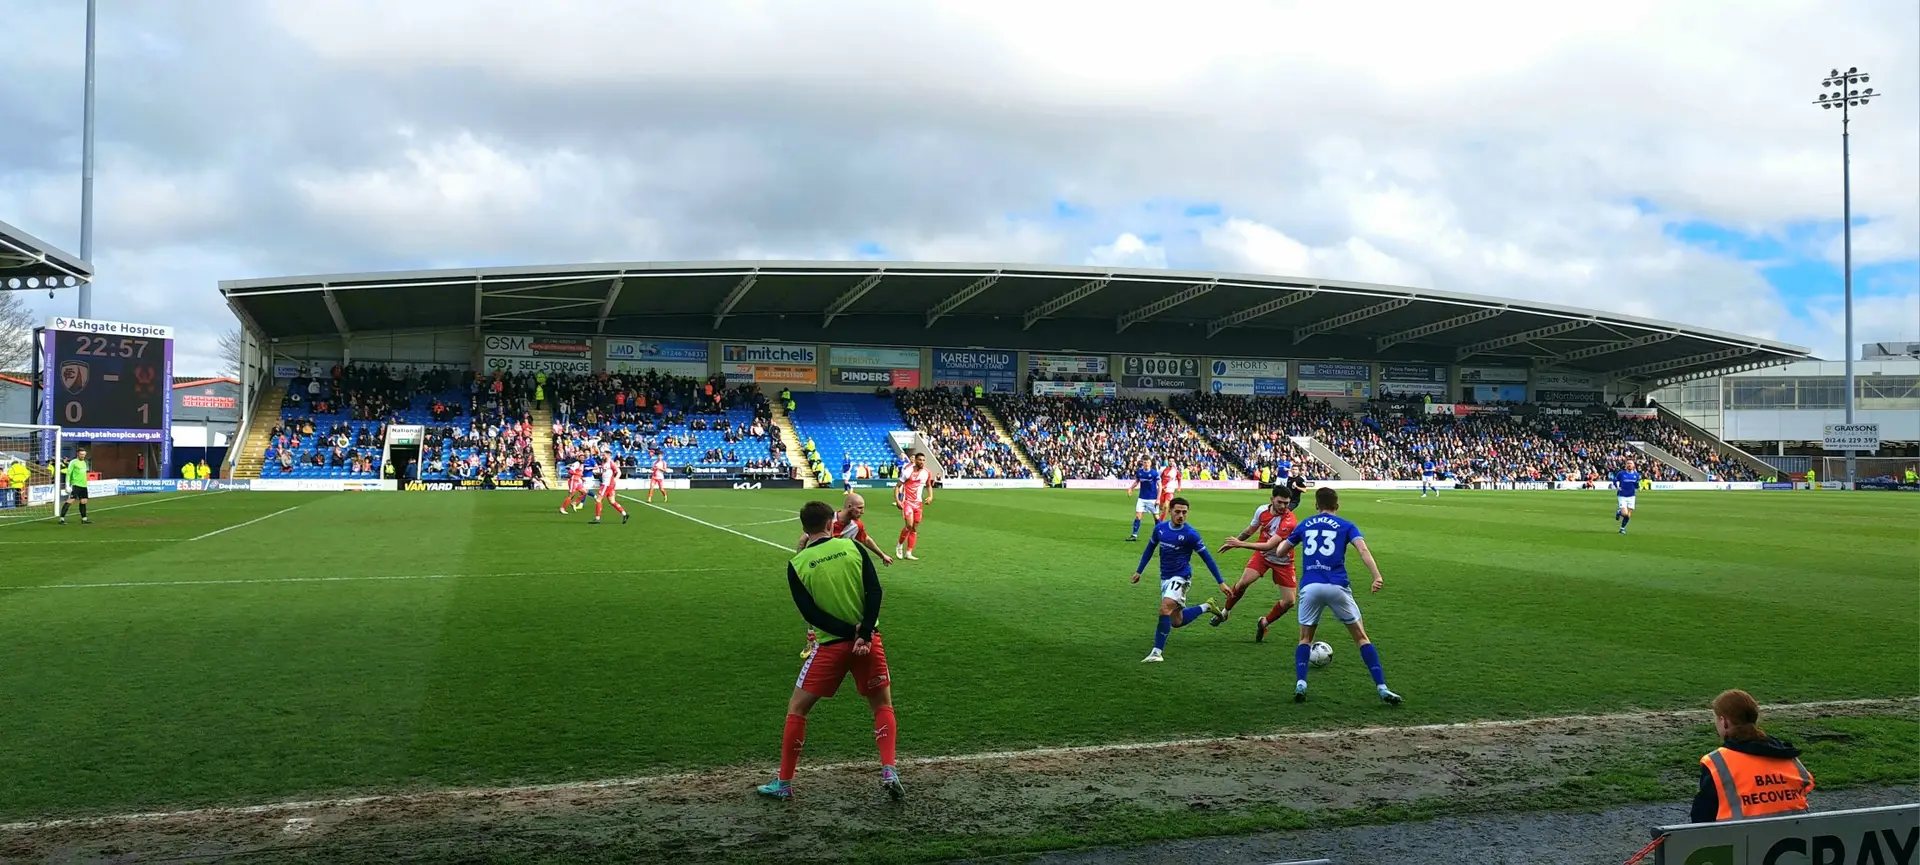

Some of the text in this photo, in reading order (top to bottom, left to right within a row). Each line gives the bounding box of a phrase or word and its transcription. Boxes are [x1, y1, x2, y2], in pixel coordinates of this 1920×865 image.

[69, 319, 166, 336] Ashgate Hospice
[75, 335, 149, 359] 22:57
[486, 336, 525, 351] GSM
[610, 343, 634, 355] LMD
[747, 346, 814, 362] mitchells
[940, 352, 1009, 365] KAREN CHILD
[519, 360, 541, 370] SELF
[543, 361, 589, 372] STORAGE
[1230, 361, 1268, 370] SHORTS
[841, 371, 891, 381] PINDERS
[1157, 379, 1185, 387] Telecom
[1553, 392, 1595, 401] Northwood
[65, 401, 83, 423] 0
[137, 403, 149, 424] 1
[1562, 407, 1583, 415] Martin
[61, 430, 161, 440] ww.ashgatehospice.org.uk
[176, 480, 202, 491] £5.99
[404, 480, 454, 491] VANYARD
[1480, 481, 1549, 490] DALTON ROOFING
[1305, 516, 1341, 530] CLEMENTS
[1303, 529, 1338, 557] 33
[816, 550, 848, 564] vanarama
[1170, 580, 1182, 591] 17
[1754, 773, 1788, 787] BALL
[1741, 788, 1804, 807] RECOVERY
